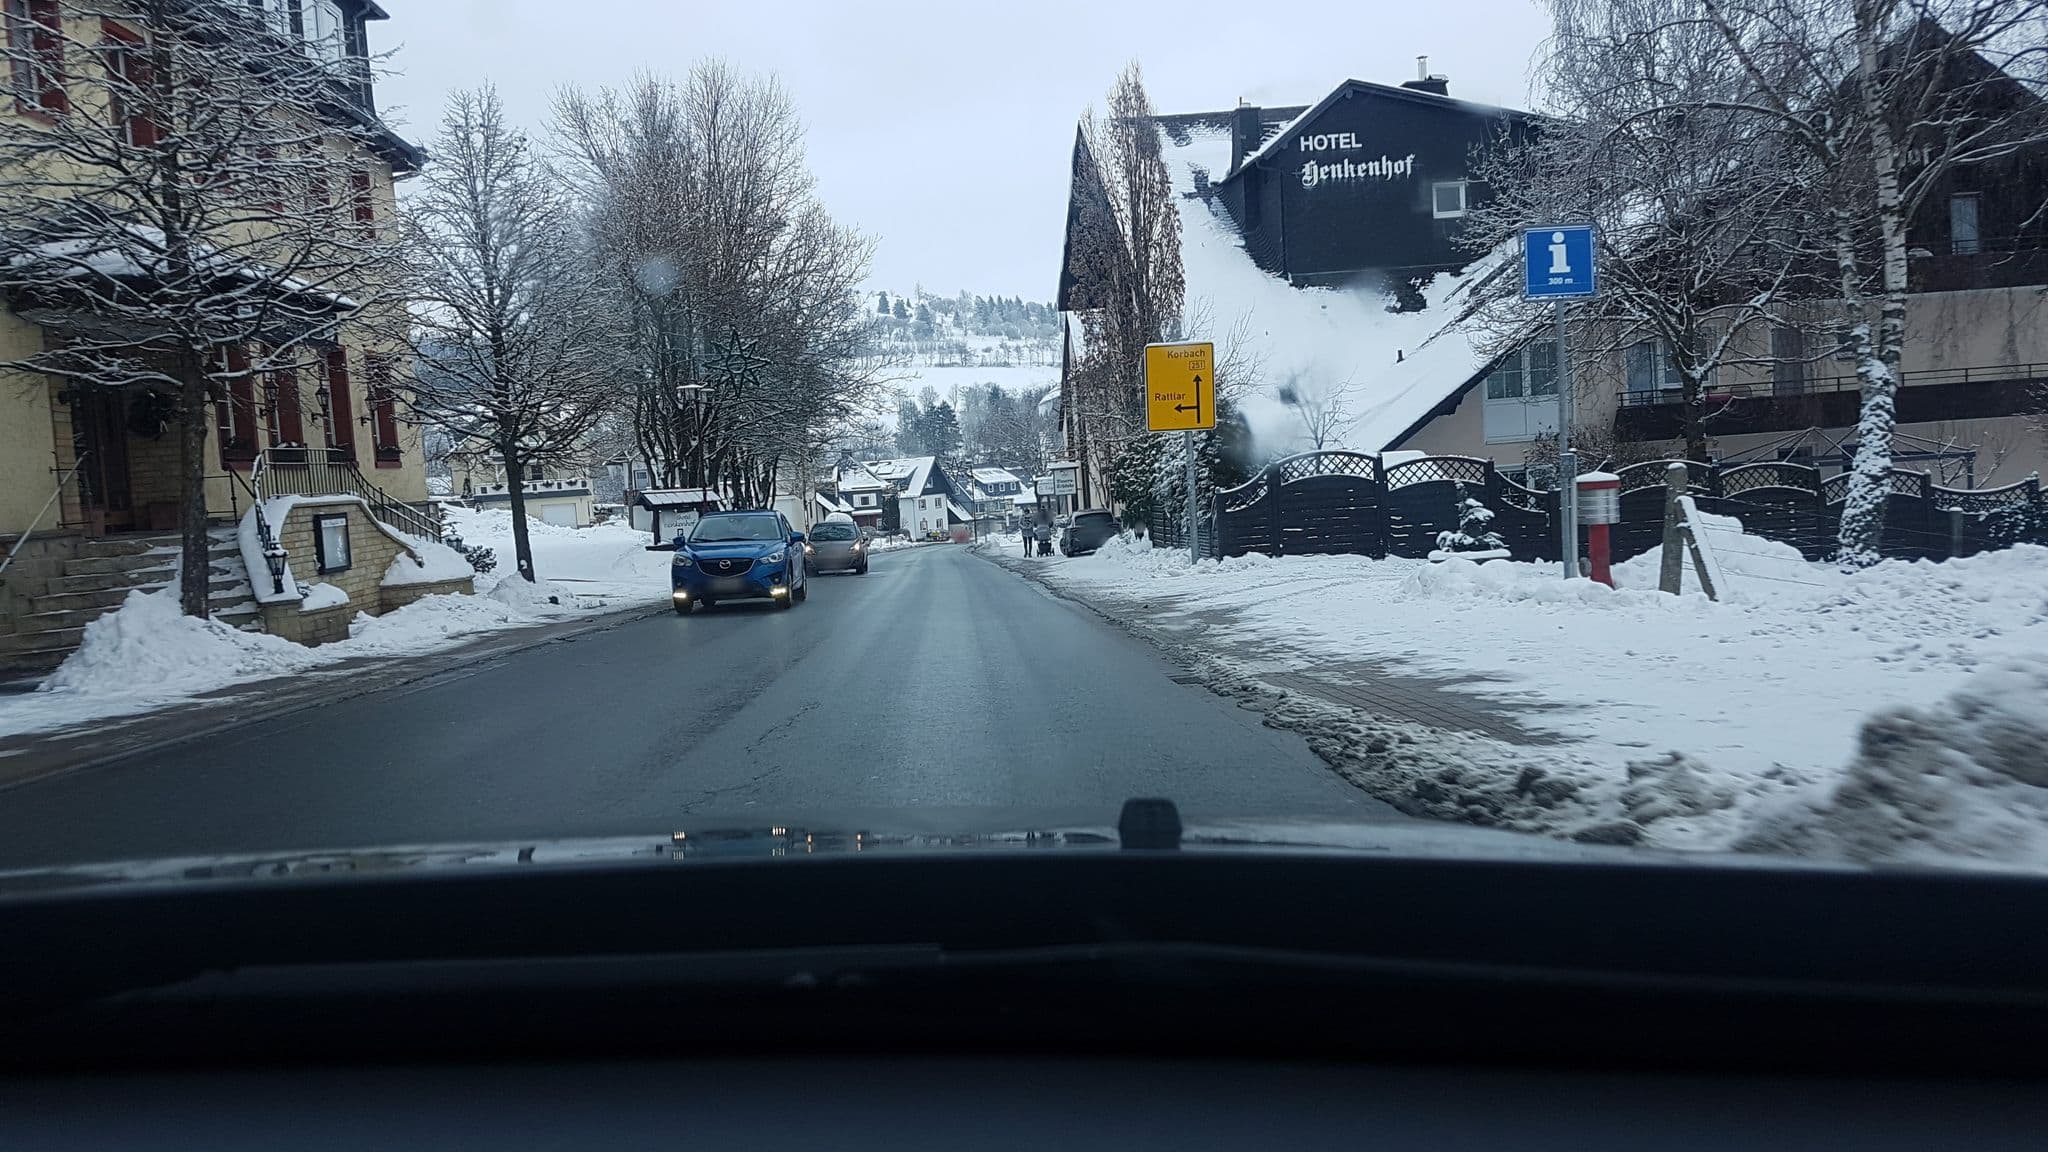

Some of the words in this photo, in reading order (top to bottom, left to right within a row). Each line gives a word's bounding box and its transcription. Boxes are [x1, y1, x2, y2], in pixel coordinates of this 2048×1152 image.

[1300, 132, 1362, 151] HOTEL
[1301, 153, 1416, 187] Henkenhof
[1167, 349, 1205, 359] Korbach
[1154, 392, 1186, 401] Rattlar
